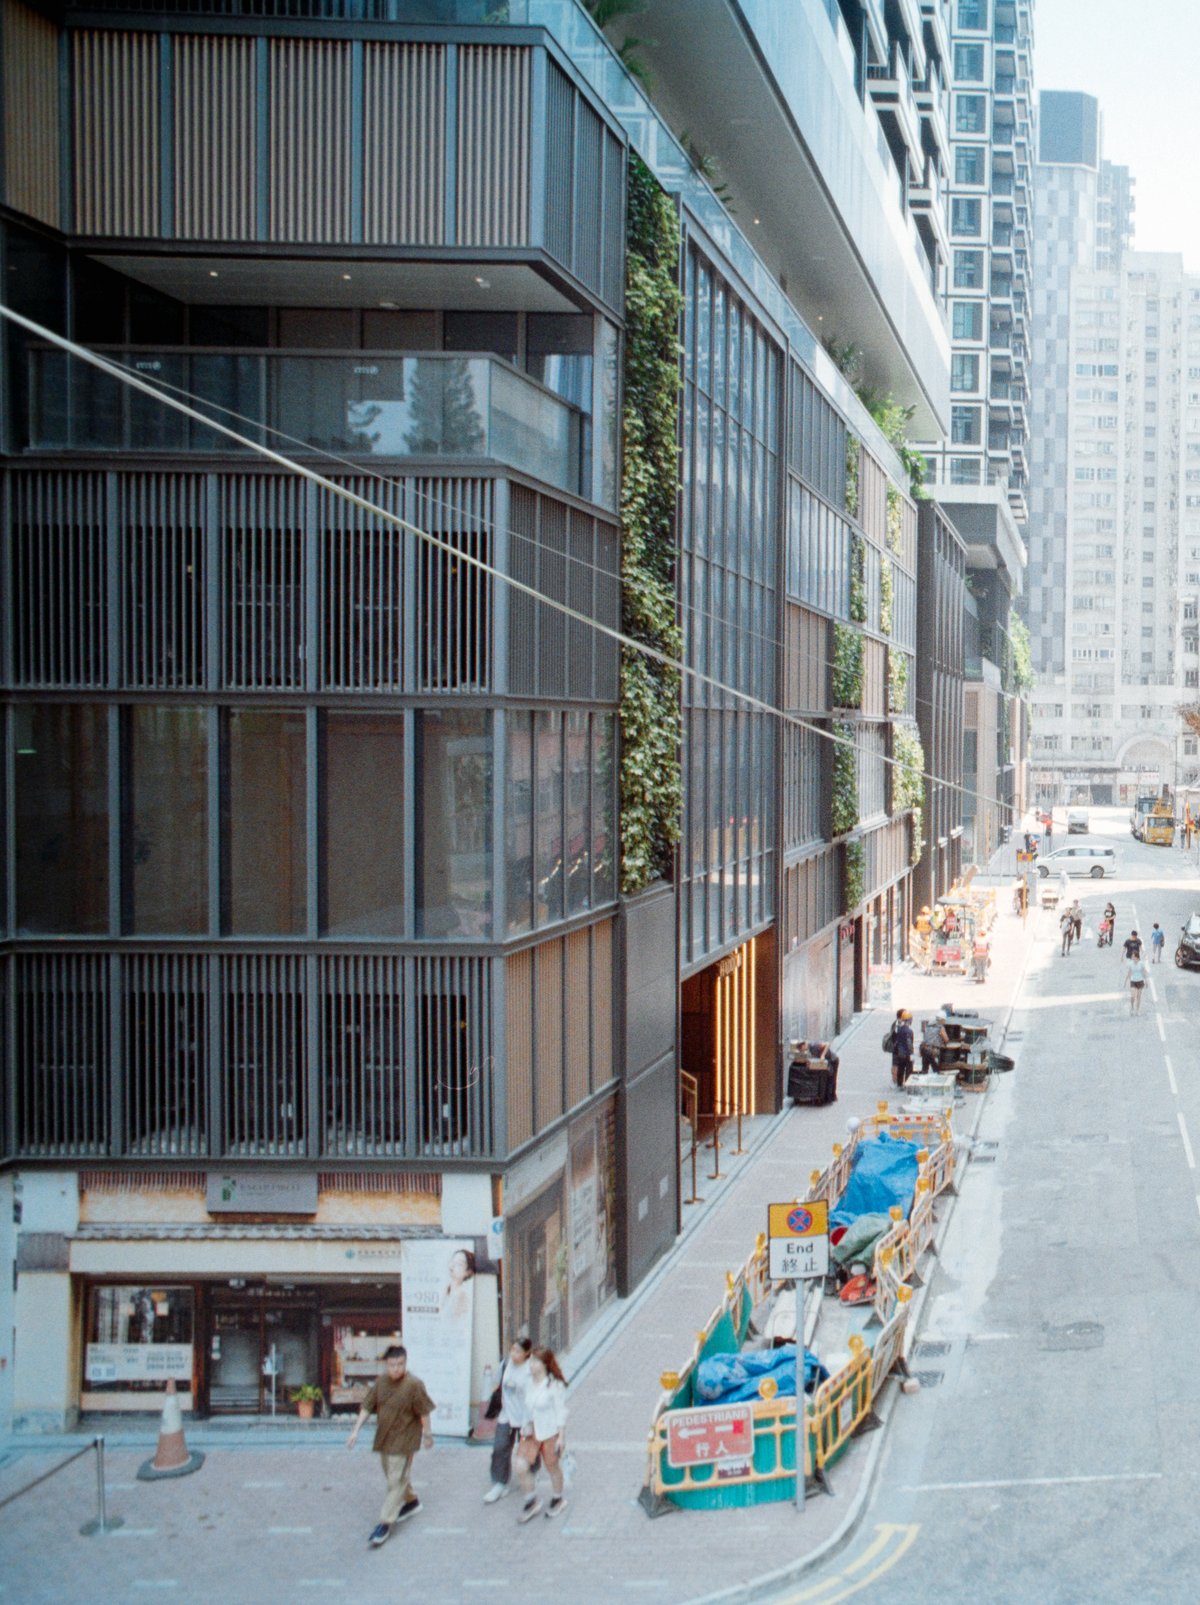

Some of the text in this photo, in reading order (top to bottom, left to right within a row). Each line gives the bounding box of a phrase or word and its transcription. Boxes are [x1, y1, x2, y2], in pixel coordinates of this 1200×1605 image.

[786, 1242, 813, 1255] End
[782, 1256, 818, 1274] 終止
[671, 1408, 748, 1428] PEDESTRIANS
[695, 1440, 729, 1459] 行人
